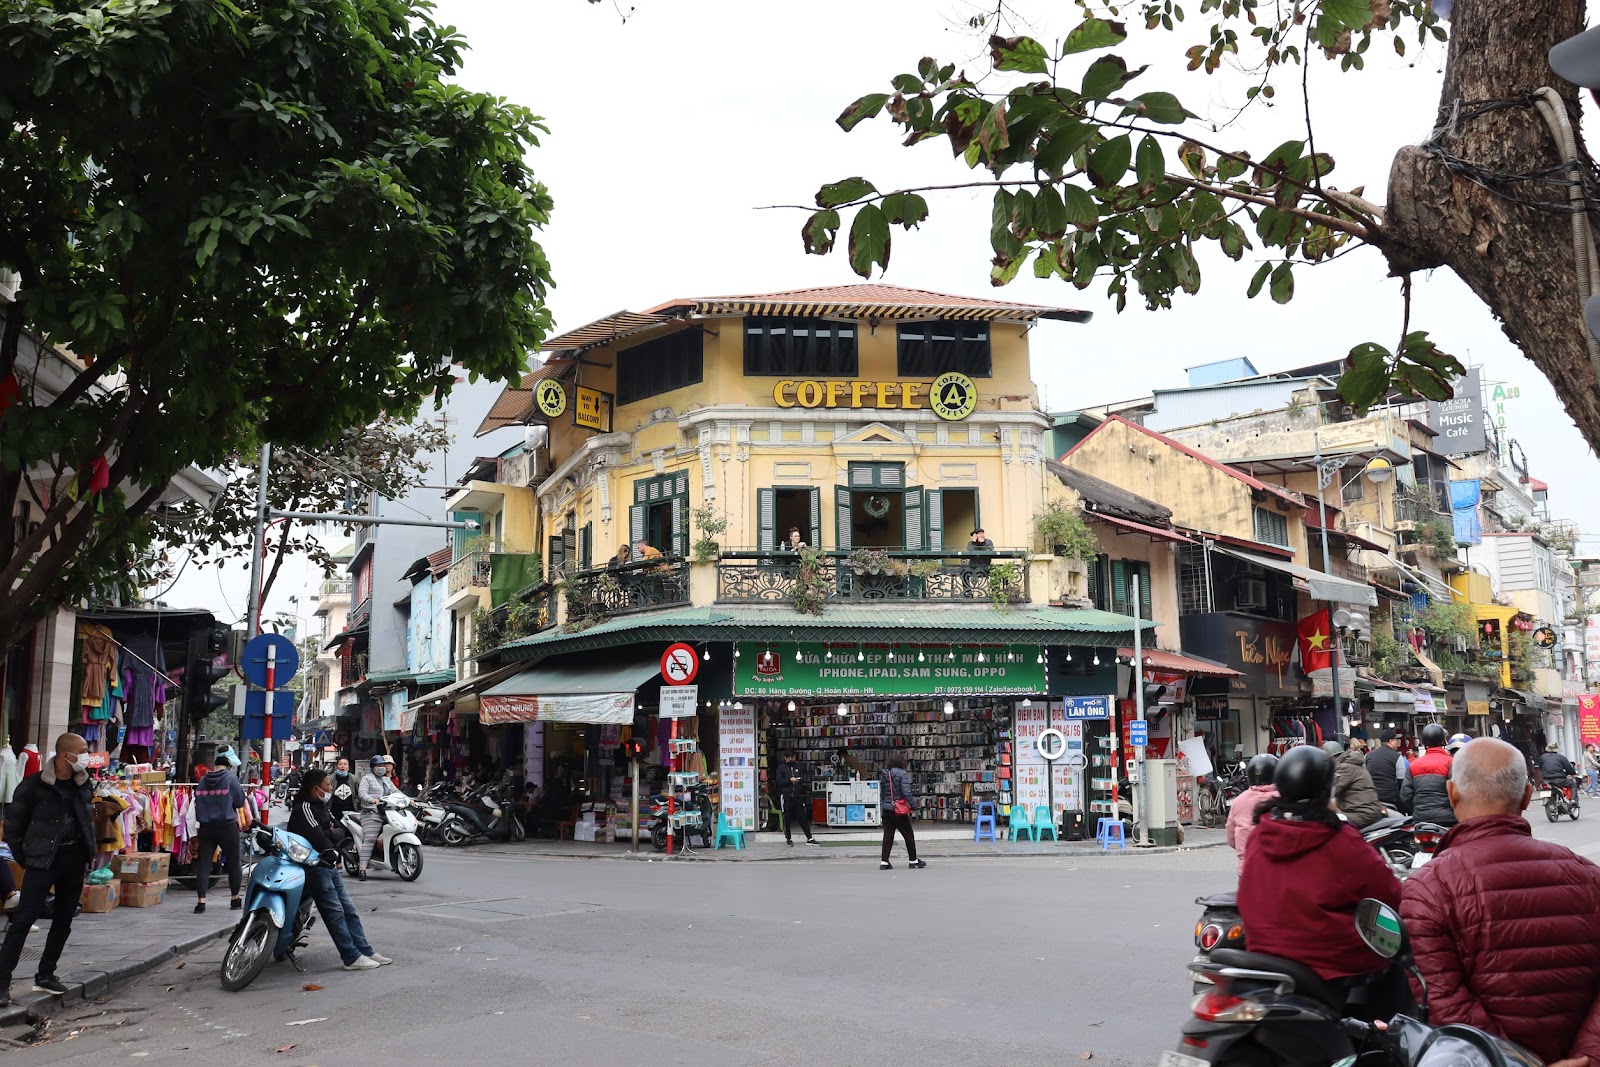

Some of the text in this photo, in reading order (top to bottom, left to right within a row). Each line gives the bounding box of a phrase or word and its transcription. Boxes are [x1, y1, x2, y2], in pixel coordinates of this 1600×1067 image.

[542, 382, 563, 394] COFFEE
[937, 375, 971, 390] COFFEE
[581, 394, 592, 403] WAY
[773, 380, 923, 409] COFFEE
[542, 402, 562, 414] COFFEE
[935, 403, 971, 417] COFFEE
[1442, 404, 1469, 412] LOUNGE
[577, 412, 599, 424] BALCONY
[1439, 413, 1473, 426] Music
[1446, 427, 1468, 437] Café
[1496, 402, 1508, 467] HOTEL
[867, 651, 882, 663] ÉP
[927, 653, 957, 663] THAY
[903, 667, 930, 677] SAM
[974, 667, 1005, 677] OPPO
[769, 686, 786, 695] Hàng
[1069, 706, 1104, 716] LÃN ÔNG
[1018, 725, 1027, 736] SIM
[1074, 725, 1080, 736] 5G
